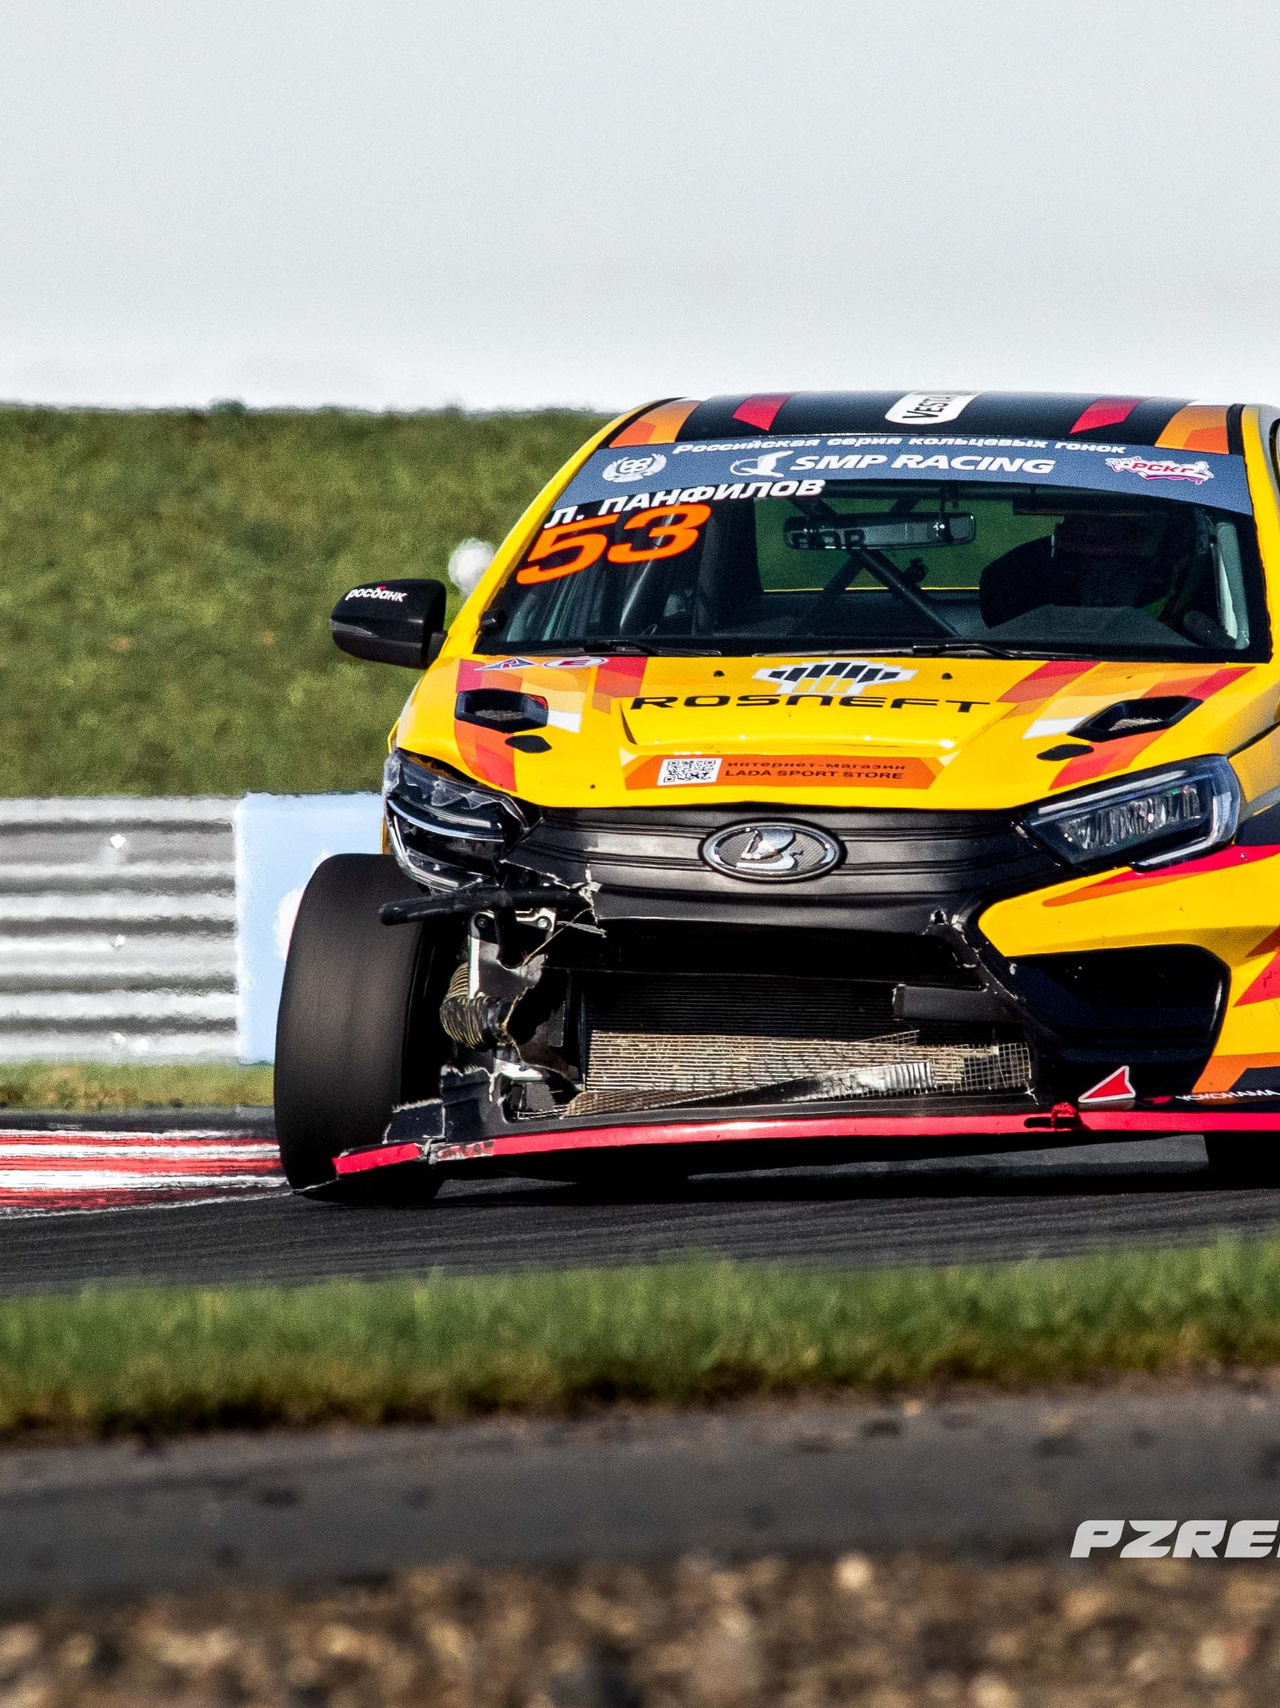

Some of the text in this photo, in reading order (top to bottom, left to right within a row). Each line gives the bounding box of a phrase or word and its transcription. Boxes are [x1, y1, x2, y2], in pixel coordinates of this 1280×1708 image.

[672, 437, 1126, 455] Российская серия кольцевых гонок
[789, 454, 1056, 474] SMP RACING
[597, 479, 827, 516] ПАНФИЛОВ
[516, 503, 711, 585] 53
[345, 586, 408, 602] росбанк
[630, 694, 990, 713] ROSNEFT
[725, 769, 905, 780] LADA SPORT STORE
